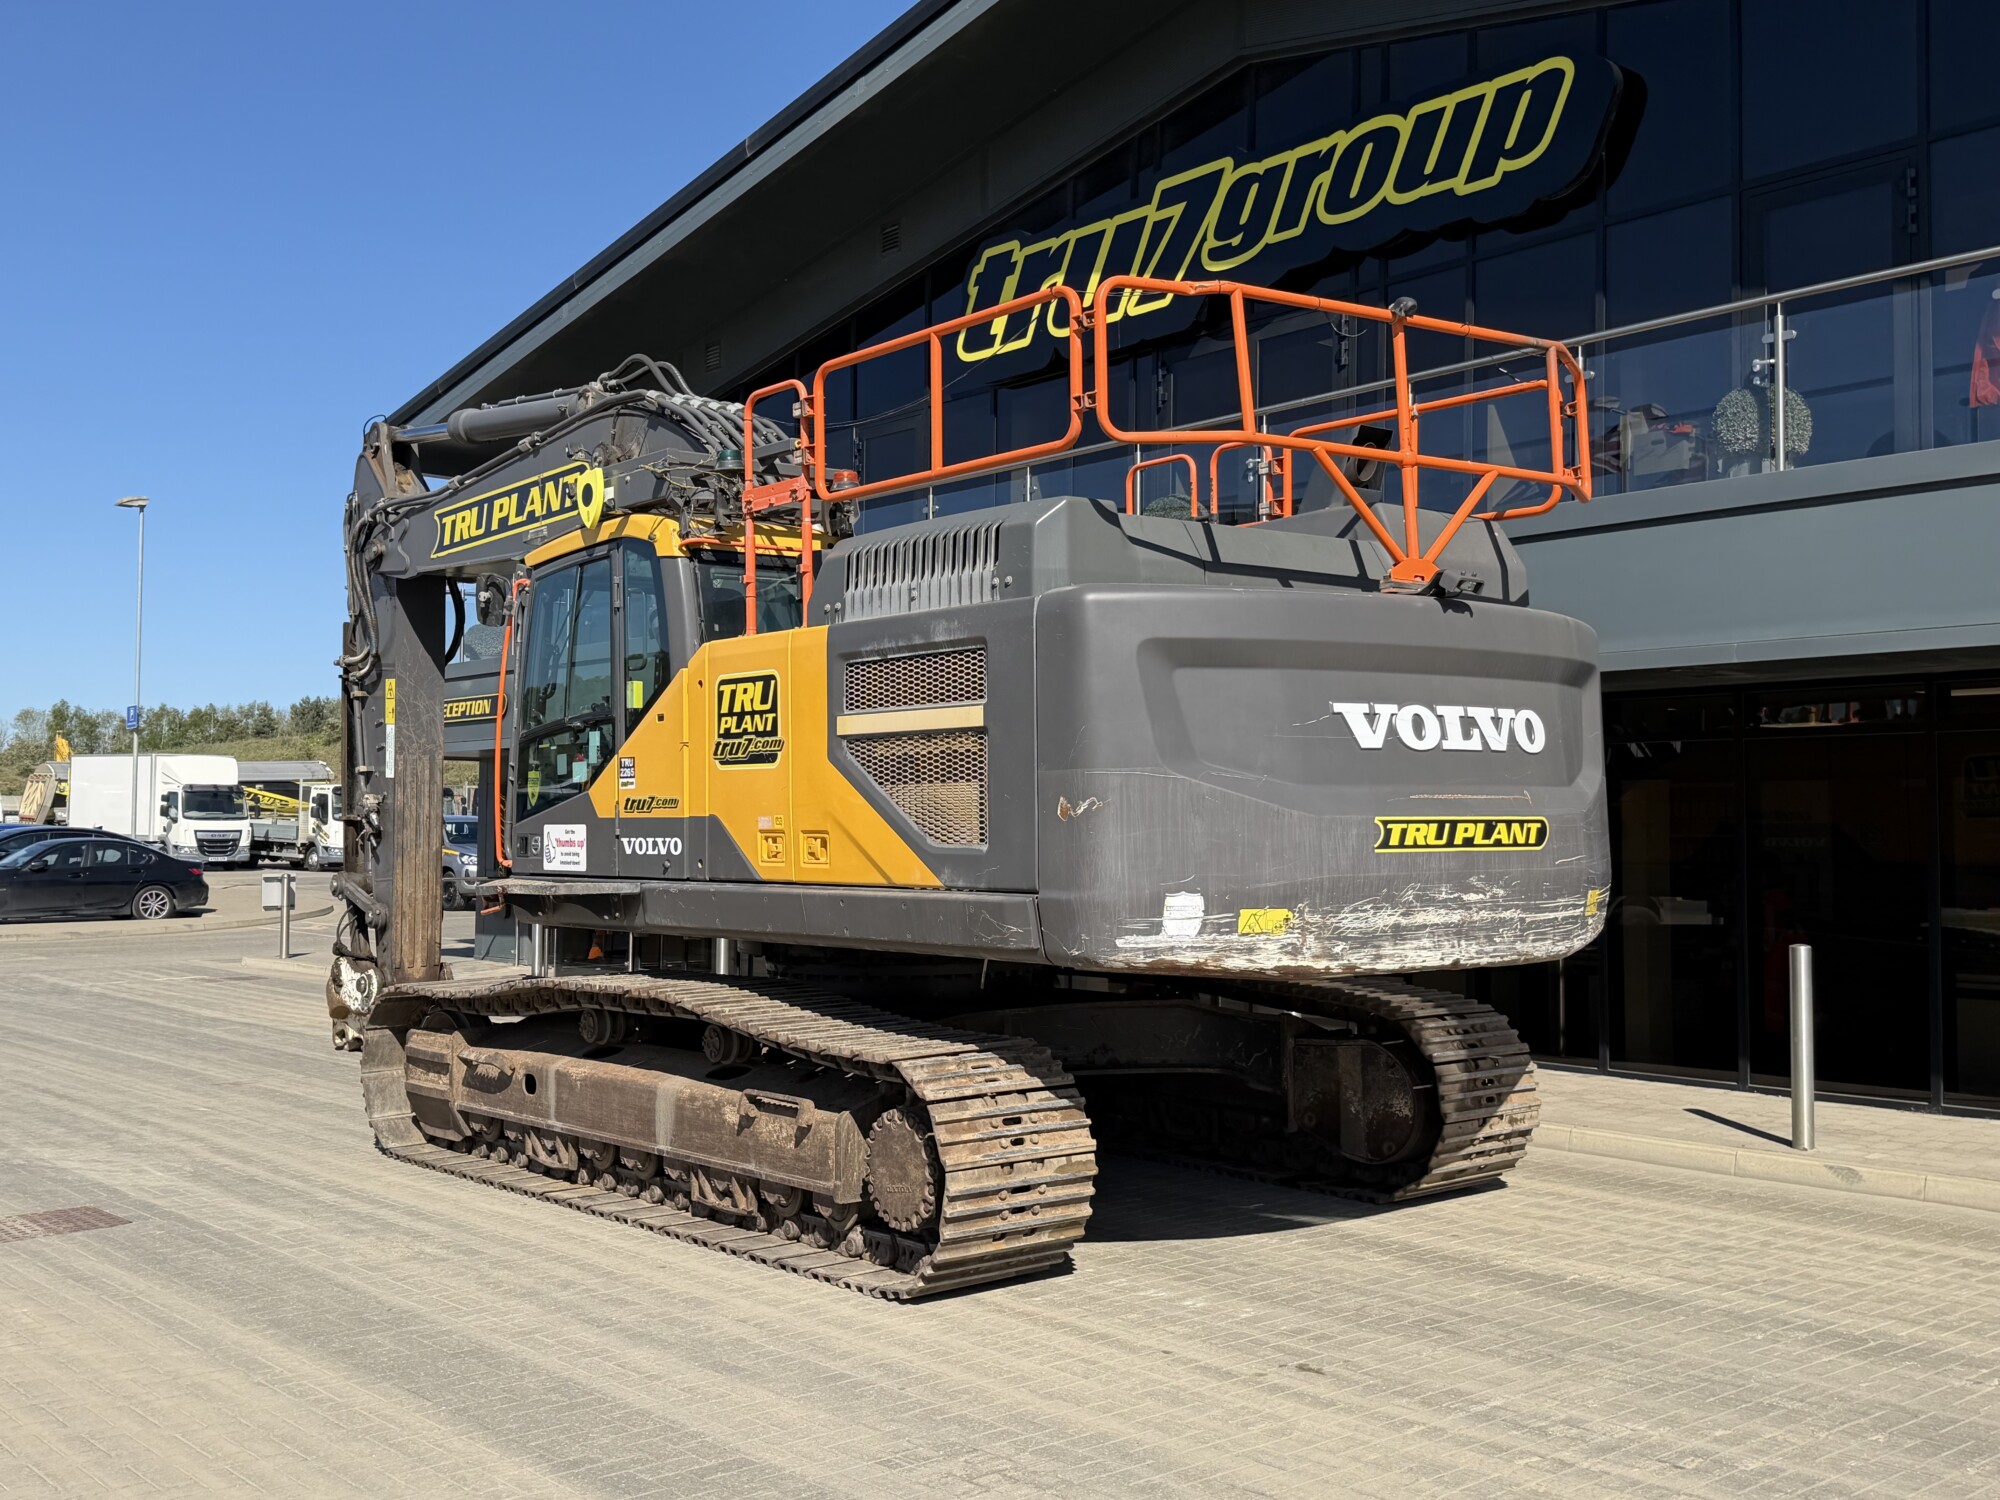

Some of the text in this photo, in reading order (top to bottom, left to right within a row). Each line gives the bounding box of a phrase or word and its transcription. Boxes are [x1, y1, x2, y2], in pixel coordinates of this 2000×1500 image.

[441, 471, 581, 546] TRU PLANT
[719, 680, 776, 713] TRU
[719, 713, 776, 734] PLANT
[1330, 702, 1546, 754] VOLVO
[712, 735, 784, 761] tru7.com
[619, 758, 634, 767] TRU
[619, 767, 635, 777] 2265
[623, 796, 680, 813] tru7.com
[1386, 822, 1542, 846] TRU PLANT
[620, 837, 682, 856] VOLVO
